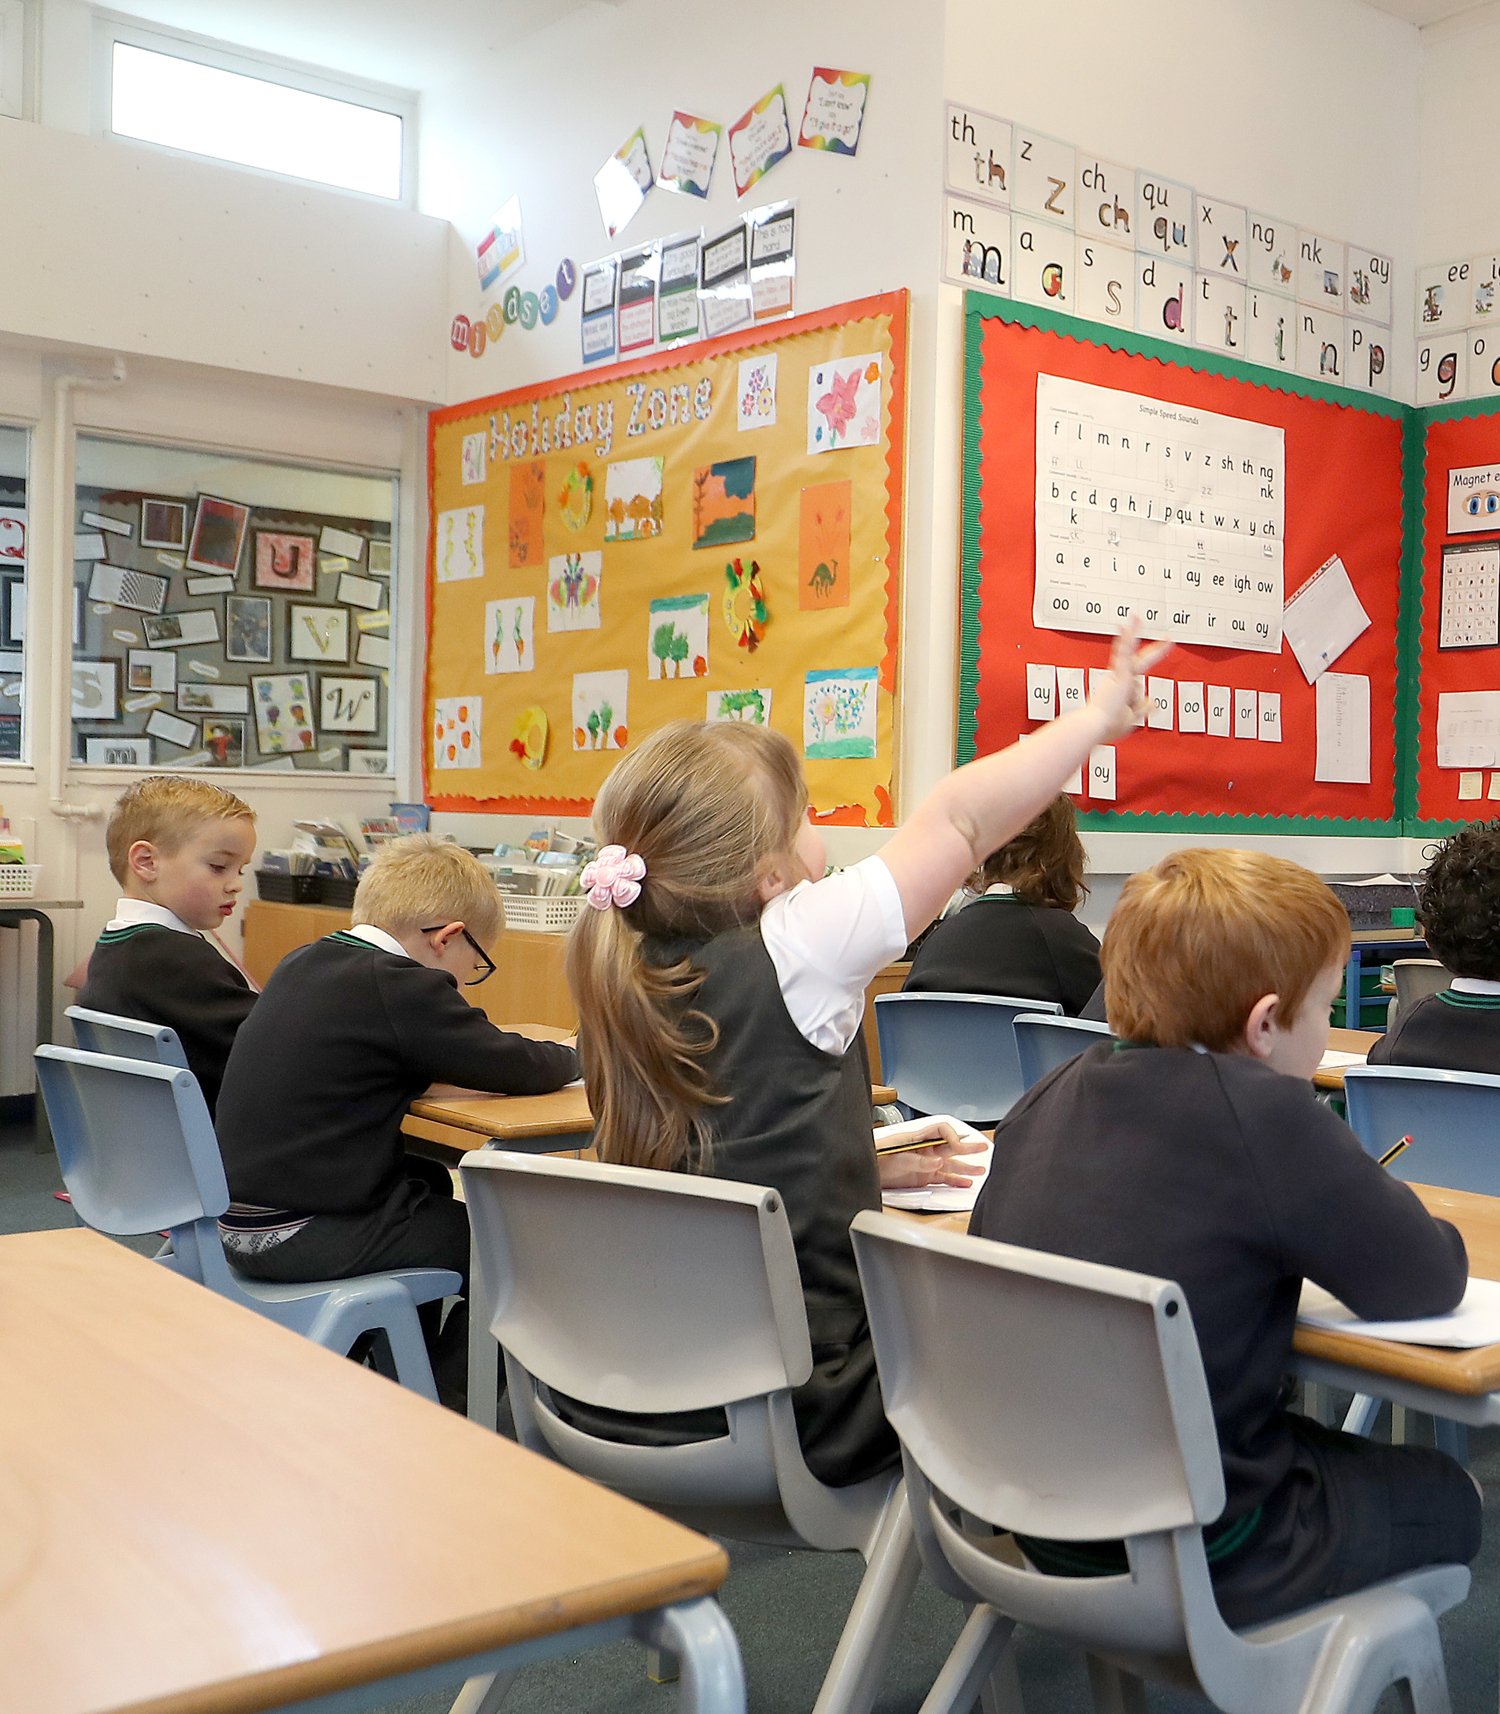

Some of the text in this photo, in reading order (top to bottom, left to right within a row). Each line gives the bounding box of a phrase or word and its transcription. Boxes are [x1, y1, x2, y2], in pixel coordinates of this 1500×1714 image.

[952, 114, 1389, 284] th z ch qu x ng nk ay
[954, 211, 1362, 346] m a s d t i n p
[1448, 264, 1469, 282] ee
[451, 258, 576, 358] mindset
[1421, 349, 1430, 371] g
[1475, 339, 1484, 355] o
[490, 378, 712, 462] Holiday Zone
[1139, 404, 1199, 425] Simple Speed Sounds
[1454, 472, 1490, 488] Magnet
[1177, 510, 1192, 524] qu
[1235, 575, 1251, 593] igh
[327, 687, 371, 721] W
[1034, 688, 1276, 722] ay ee oo ar or air
[1095, 767, 1109, 783] oy
